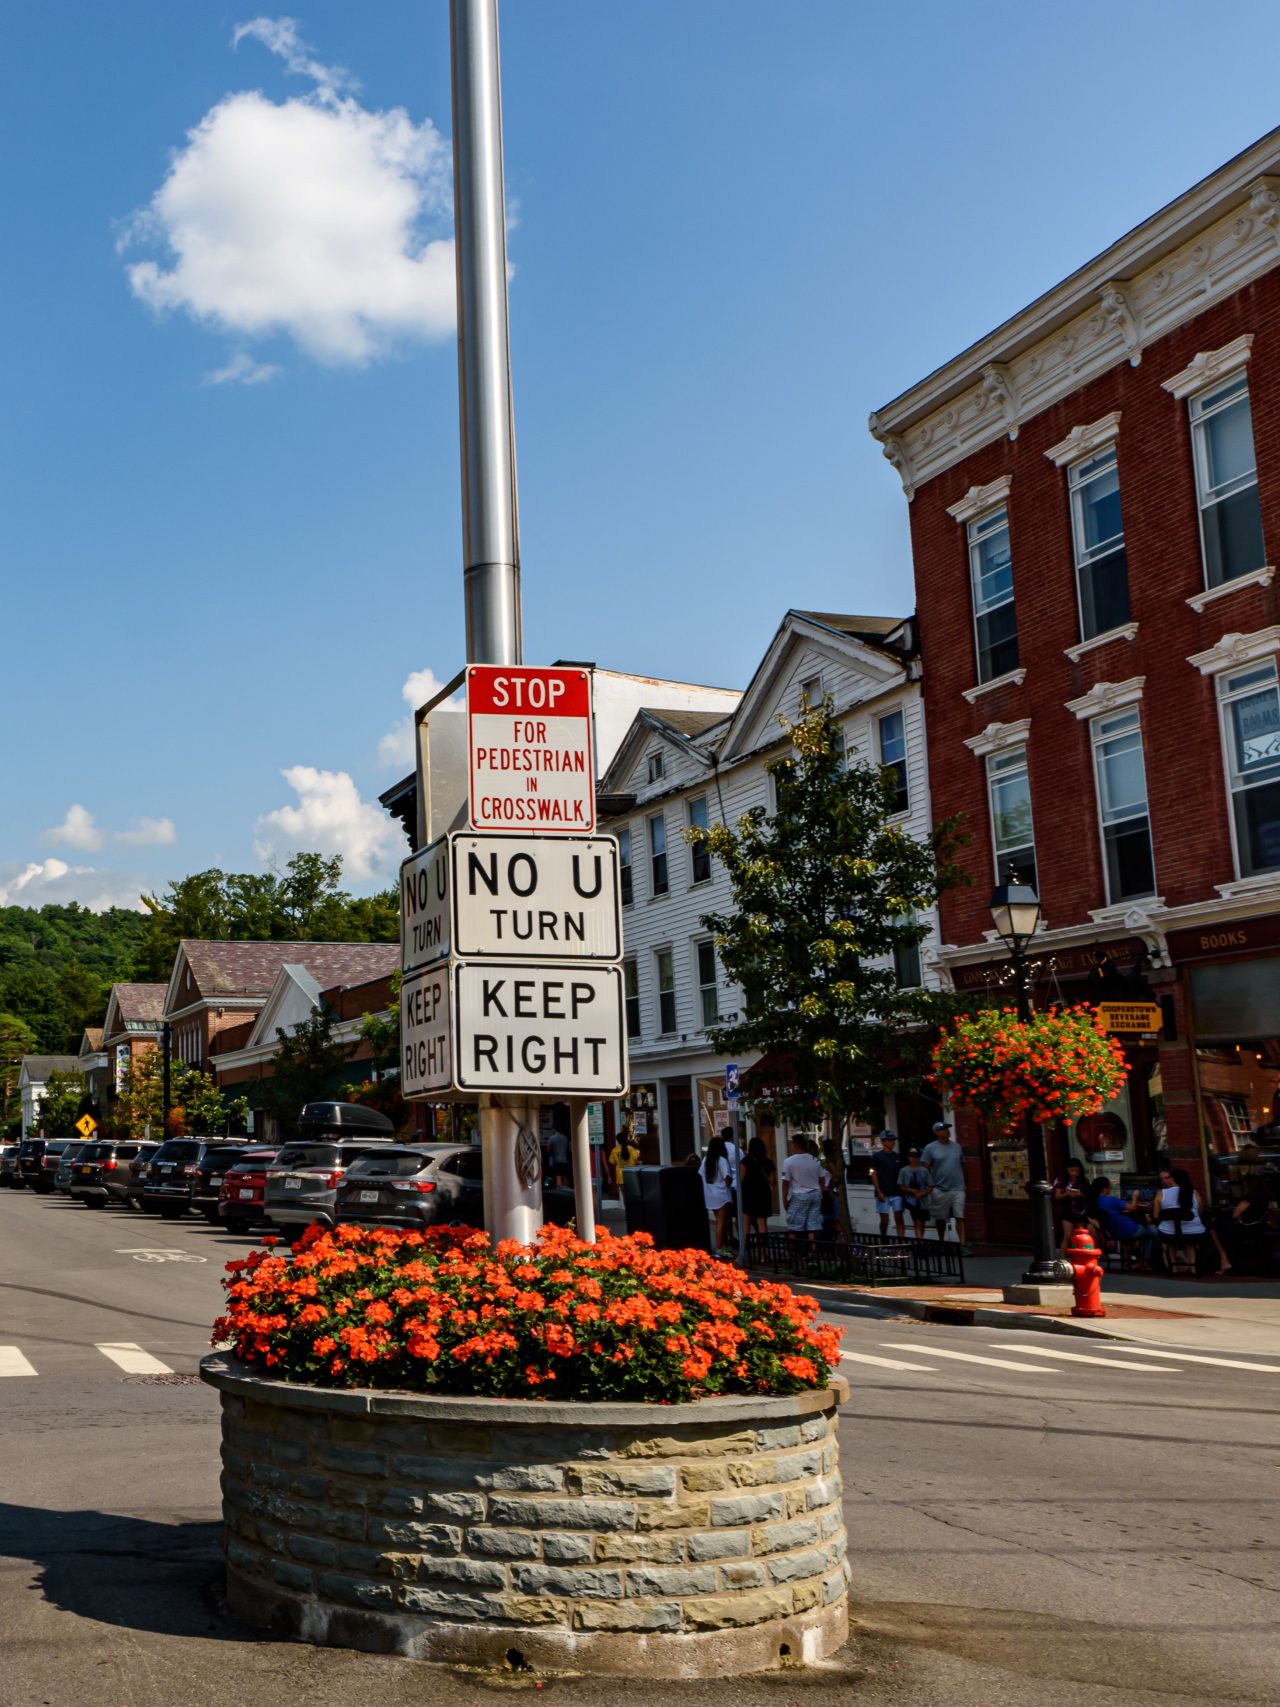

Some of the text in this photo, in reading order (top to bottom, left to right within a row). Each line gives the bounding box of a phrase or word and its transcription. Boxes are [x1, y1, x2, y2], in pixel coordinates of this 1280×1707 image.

[493, 677, 566, 709] STOP
[514, 721, 546, 744] FOR
[477, 748, 585, 773] PEDESTRIAN
[526, 777, 538, 793] IN
[481, 797, 585, 822] CROSSWALK
[406, 855, 447, 917] NO U
[468, 852, 602, 900] NO U
[412, 914, 442, 955] TURN
[490, 909, 585, 941] TURN
[1201, 930, 1247, 950] BOOKS
[407, 982, 442, 1029] KEEP
[482, 979, 596, 1020] KEEP
[405, 1035, 446, 1081] RIGHT
[473, 1034, 607, 1076] RIGHT
